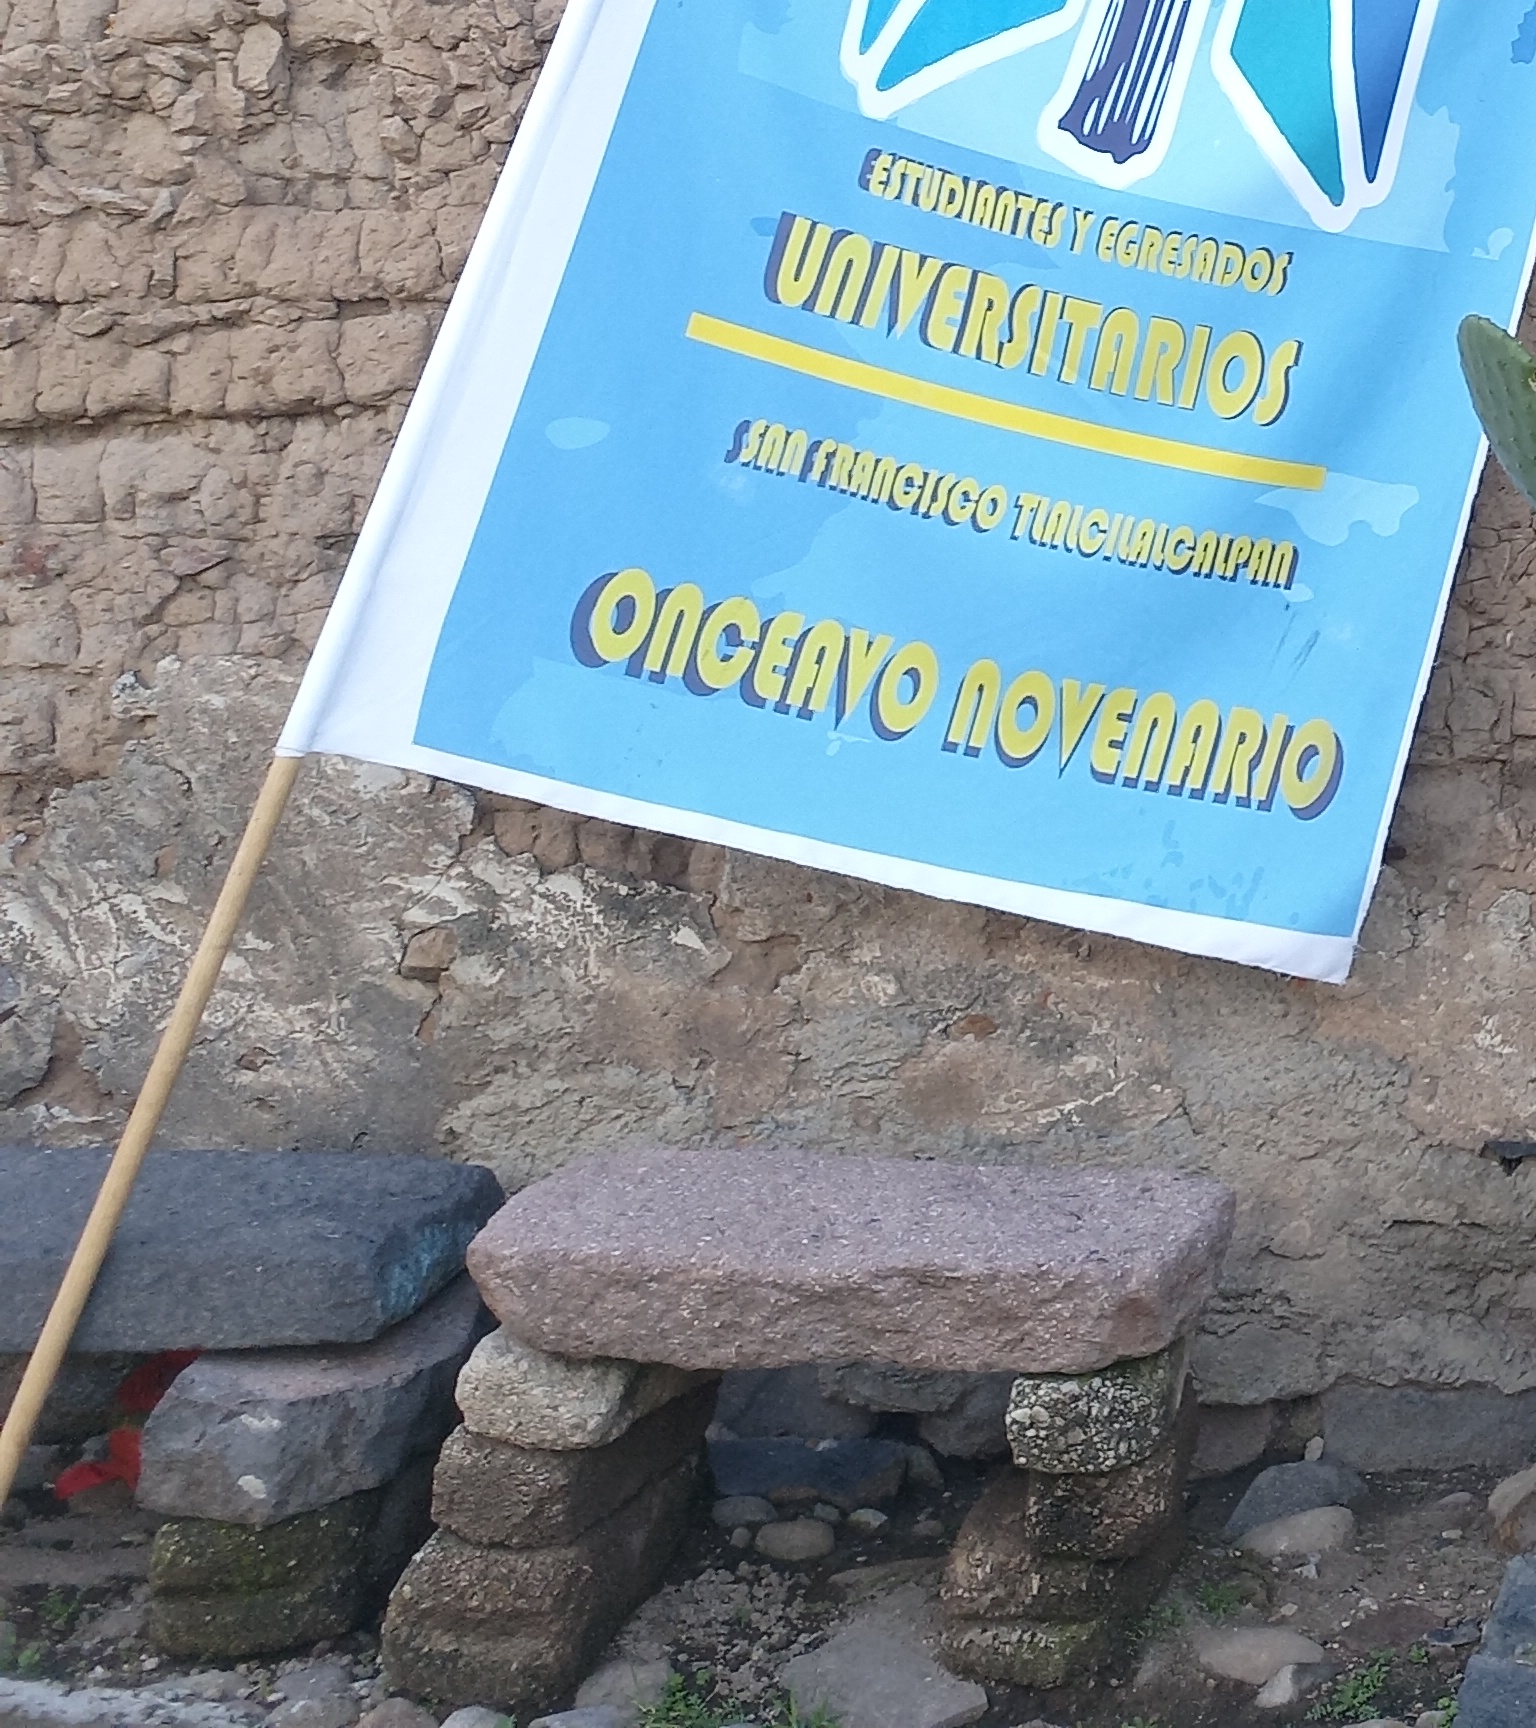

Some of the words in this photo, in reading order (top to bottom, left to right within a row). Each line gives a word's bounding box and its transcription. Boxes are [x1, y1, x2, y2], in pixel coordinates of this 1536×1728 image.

[765, 211, 1303, 426] UNIVERSITARIOS
[860, 149, 1068, 249] ESTUDIANTES
[1070, 206, 1097, 256] Y
[1096, 215, 1295, 297] EGRESADOS
[726, 418, 809, 476] SAN
[800, 438, 1008, 533] FRANCISCO
[1010, 492, 1300, 590] TLALCILALCALPAN
[570, 568, 939, 741] ONCEAVO
[942, 658, 1344, 820] NOVENARIO
